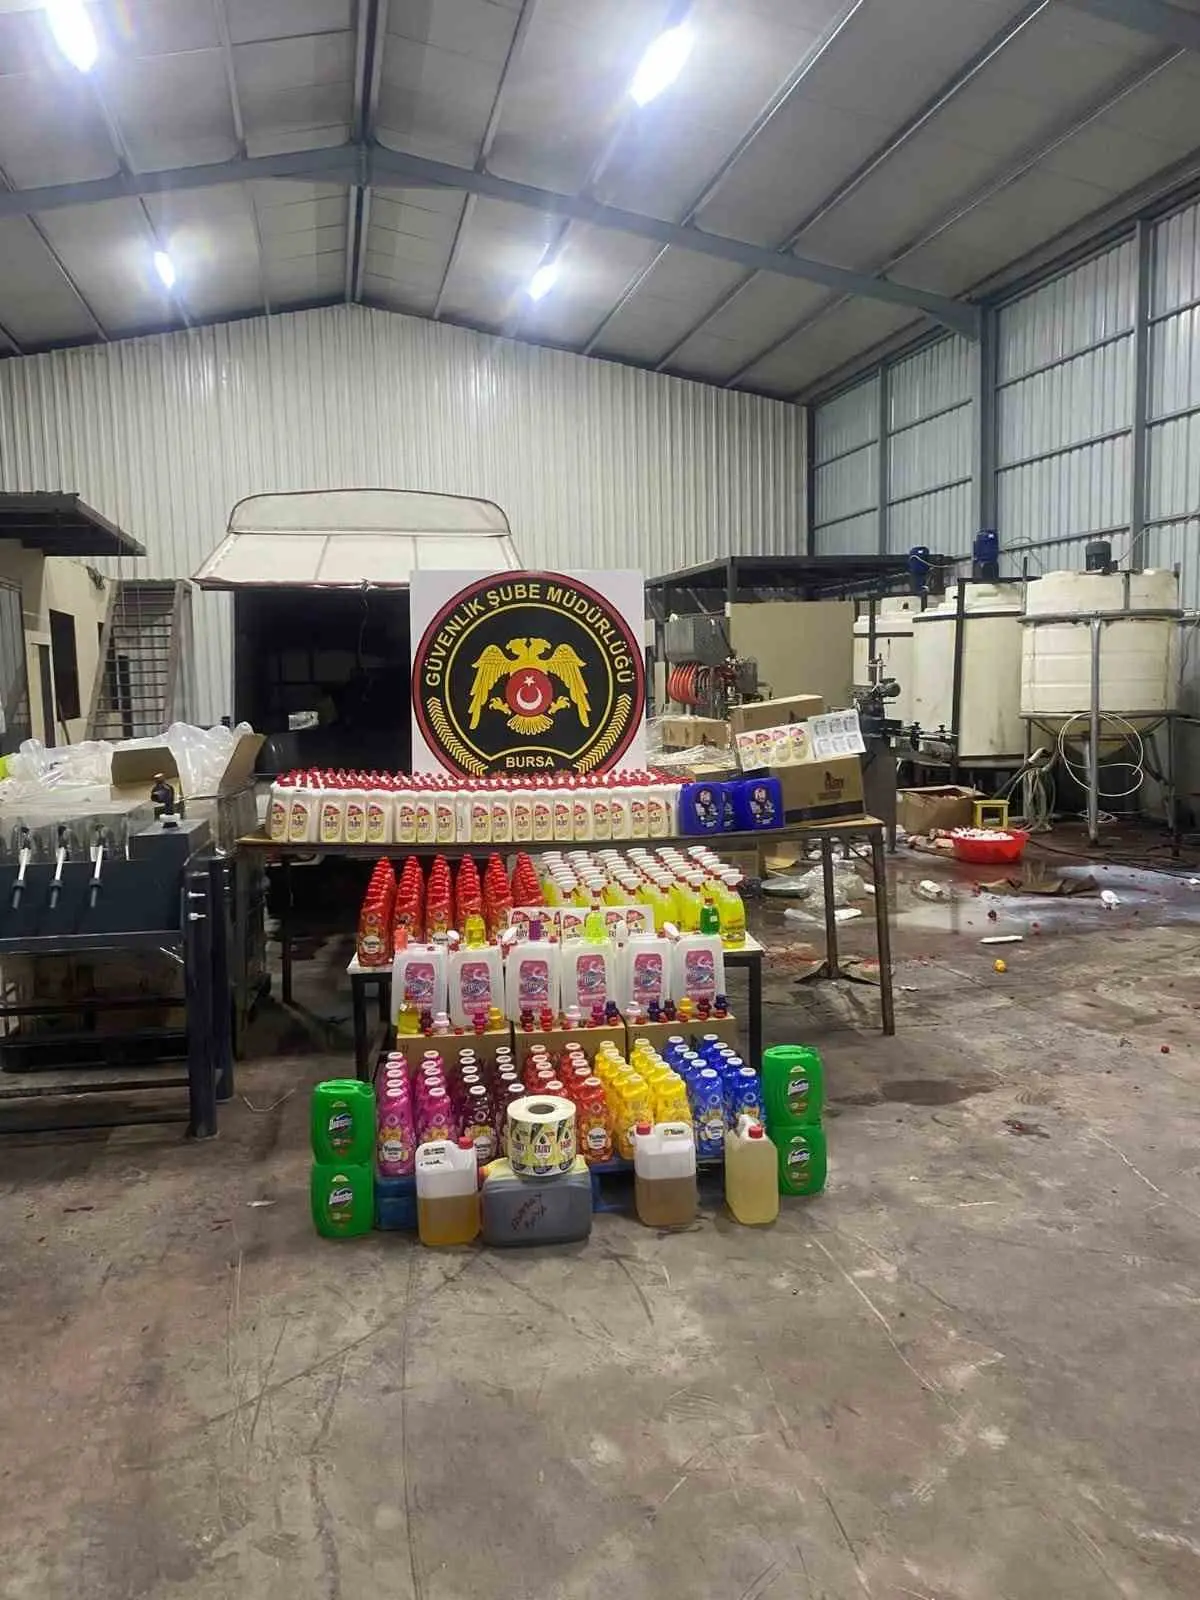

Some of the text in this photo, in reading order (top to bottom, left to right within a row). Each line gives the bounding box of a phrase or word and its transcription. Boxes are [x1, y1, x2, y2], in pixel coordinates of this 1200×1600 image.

[425, 583, 636, 687] GÜVENLİK ŞUBE MÜDÜRLÜĞÜ
[506, 756, 555, 768] BURSA
